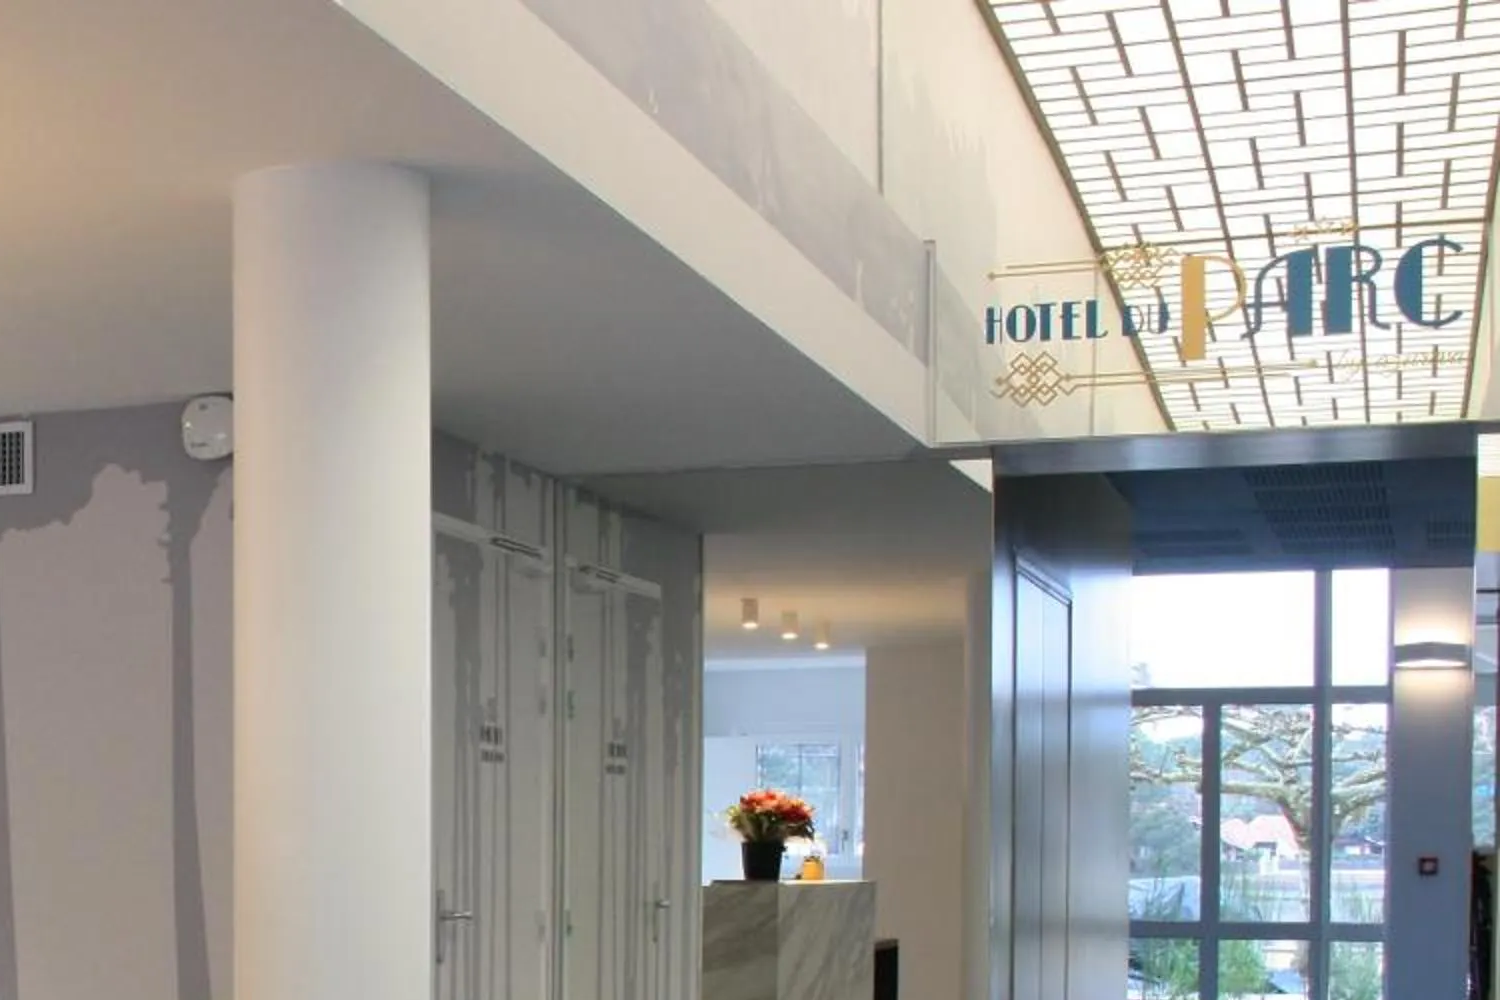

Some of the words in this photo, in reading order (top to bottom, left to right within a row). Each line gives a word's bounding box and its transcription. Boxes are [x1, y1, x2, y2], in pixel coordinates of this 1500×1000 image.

[985, 299, 1109, 345] HOTEL
[1121, 300, 1170, 337] DU
[1181, 233, 1464, 361] PARC
